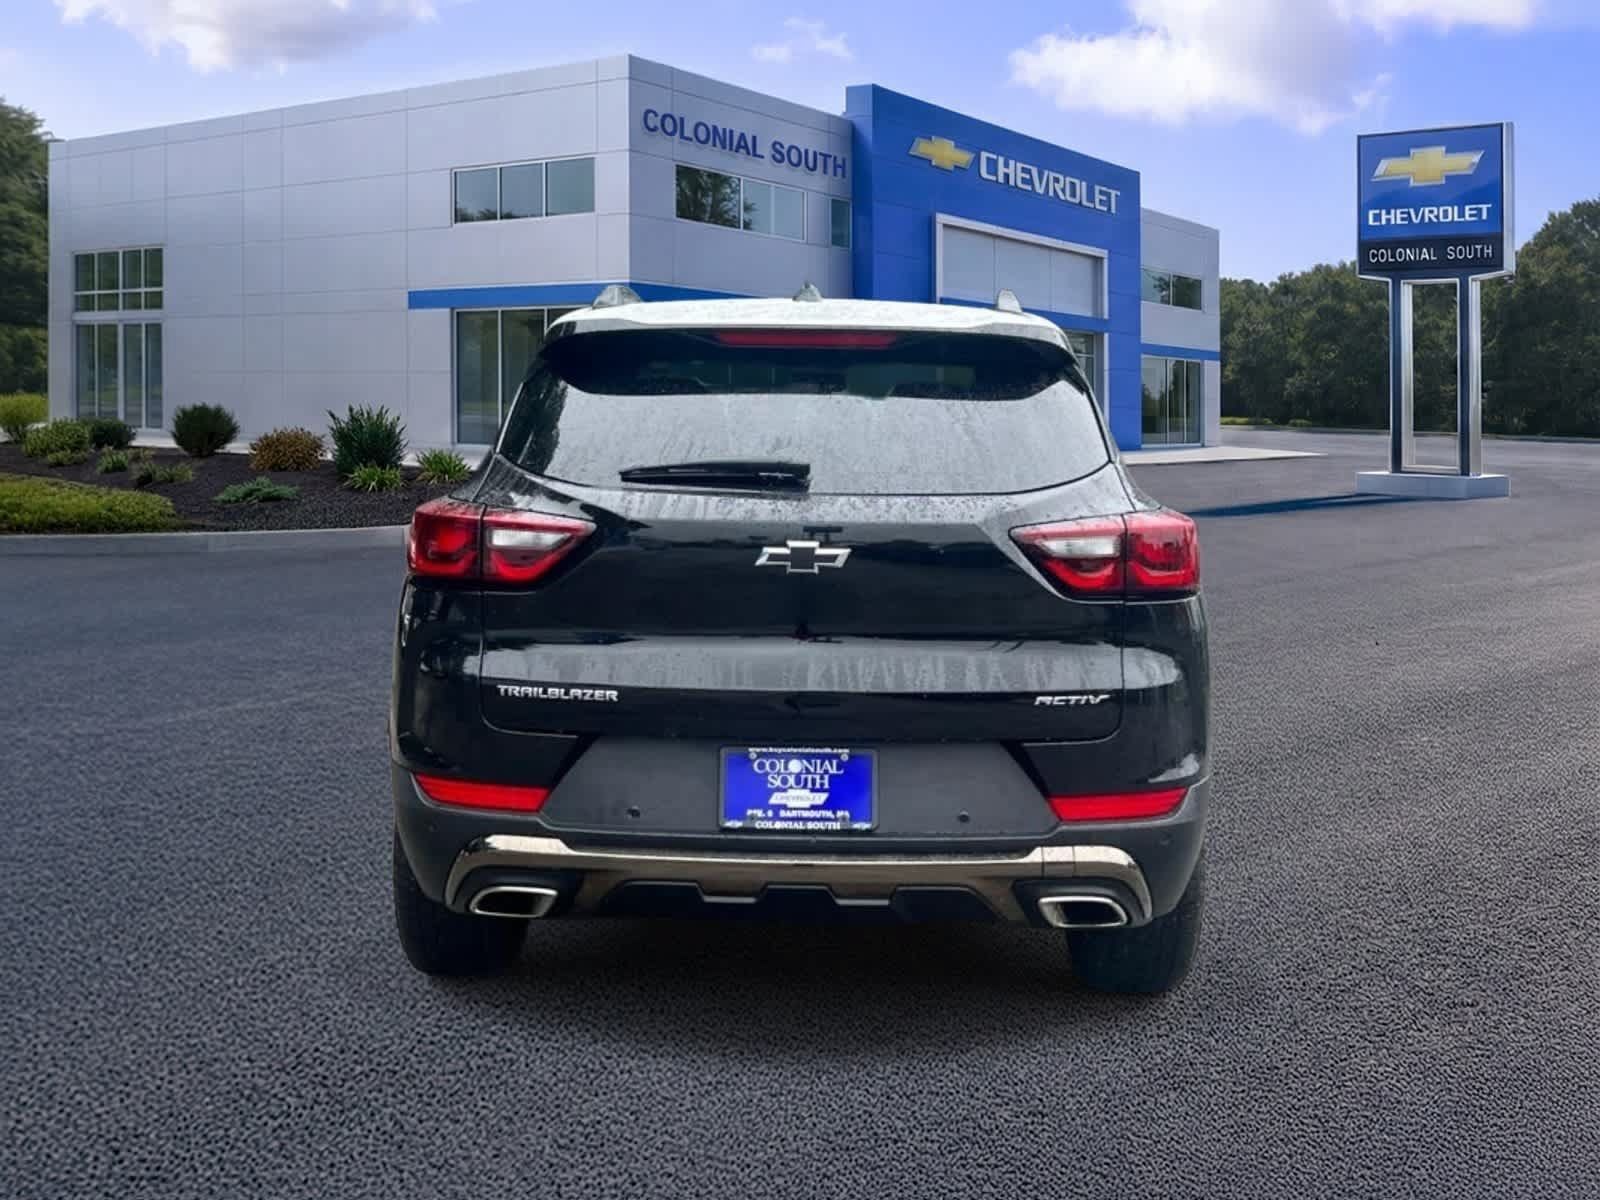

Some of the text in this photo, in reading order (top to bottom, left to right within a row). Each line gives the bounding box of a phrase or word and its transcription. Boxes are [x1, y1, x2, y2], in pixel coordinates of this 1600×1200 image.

[643, 108, 847, 178] COLONIAL SOUTH
[979, 151, 1120, 214] CHEVROLET
[1368, 204, 1492, 226] CHEVROLET
[1369, 245, 1492, 263] COLONIAL SOUTH
[497, 684, 618, 701] TRAILBLAZER
[1034, 694, 1111, 705] ACTIV
[753, 759, 844, 774] COLONIAL
[767, 774, 830, 789] SOUTH
[755, 821, 841, 830] COLONIAL SOUTH
